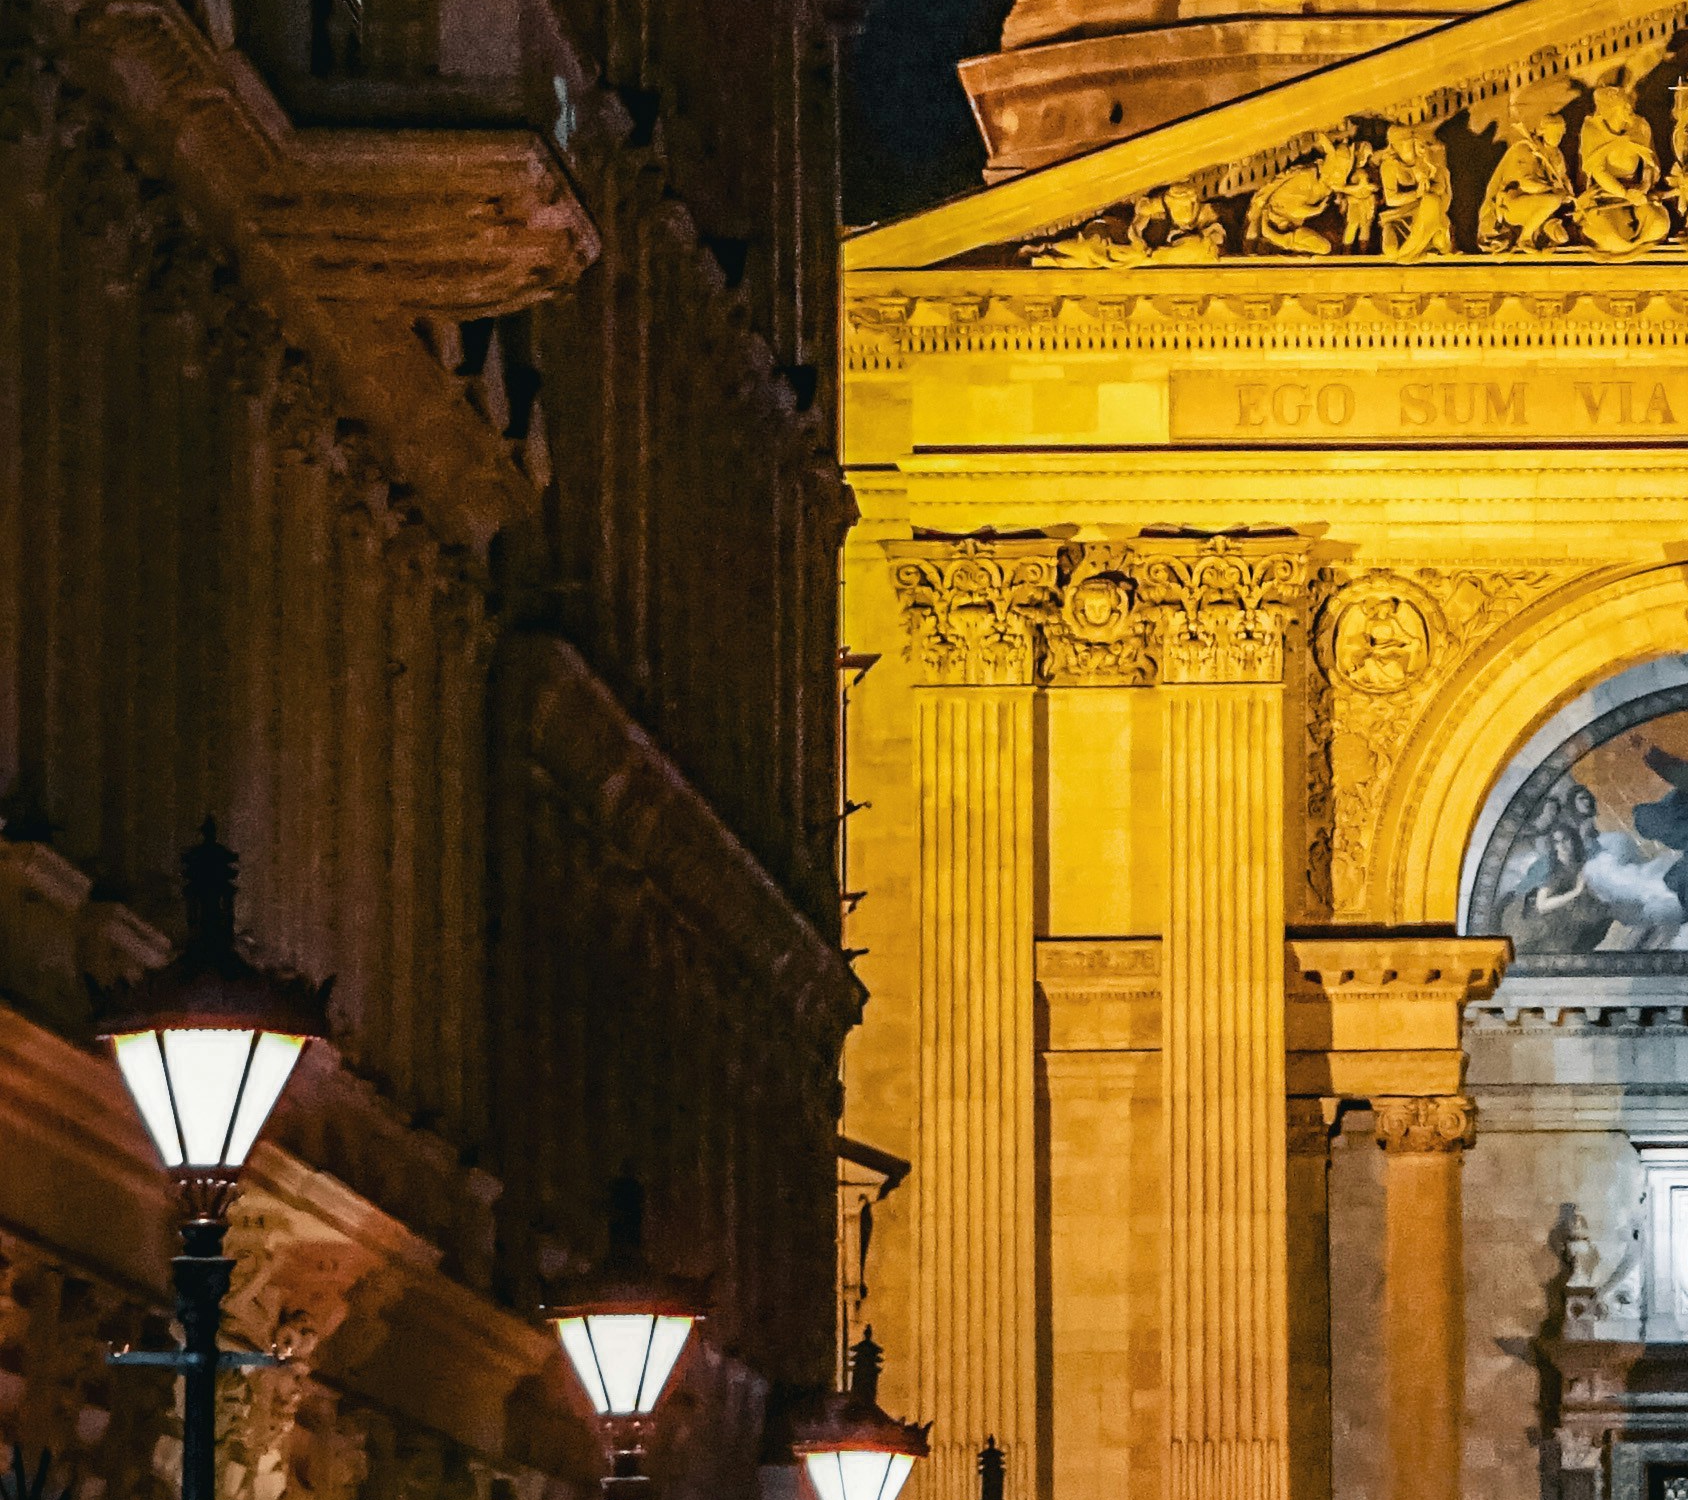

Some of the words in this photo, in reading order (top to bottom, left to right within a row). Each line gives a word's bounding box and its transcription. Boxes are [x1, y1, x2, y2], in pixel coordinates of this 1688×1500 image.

[1235, 382, 1356, 426] EGO
[1400, 381, 1528, 426] SUM
[1573, 380, 1678, 425] VIA
